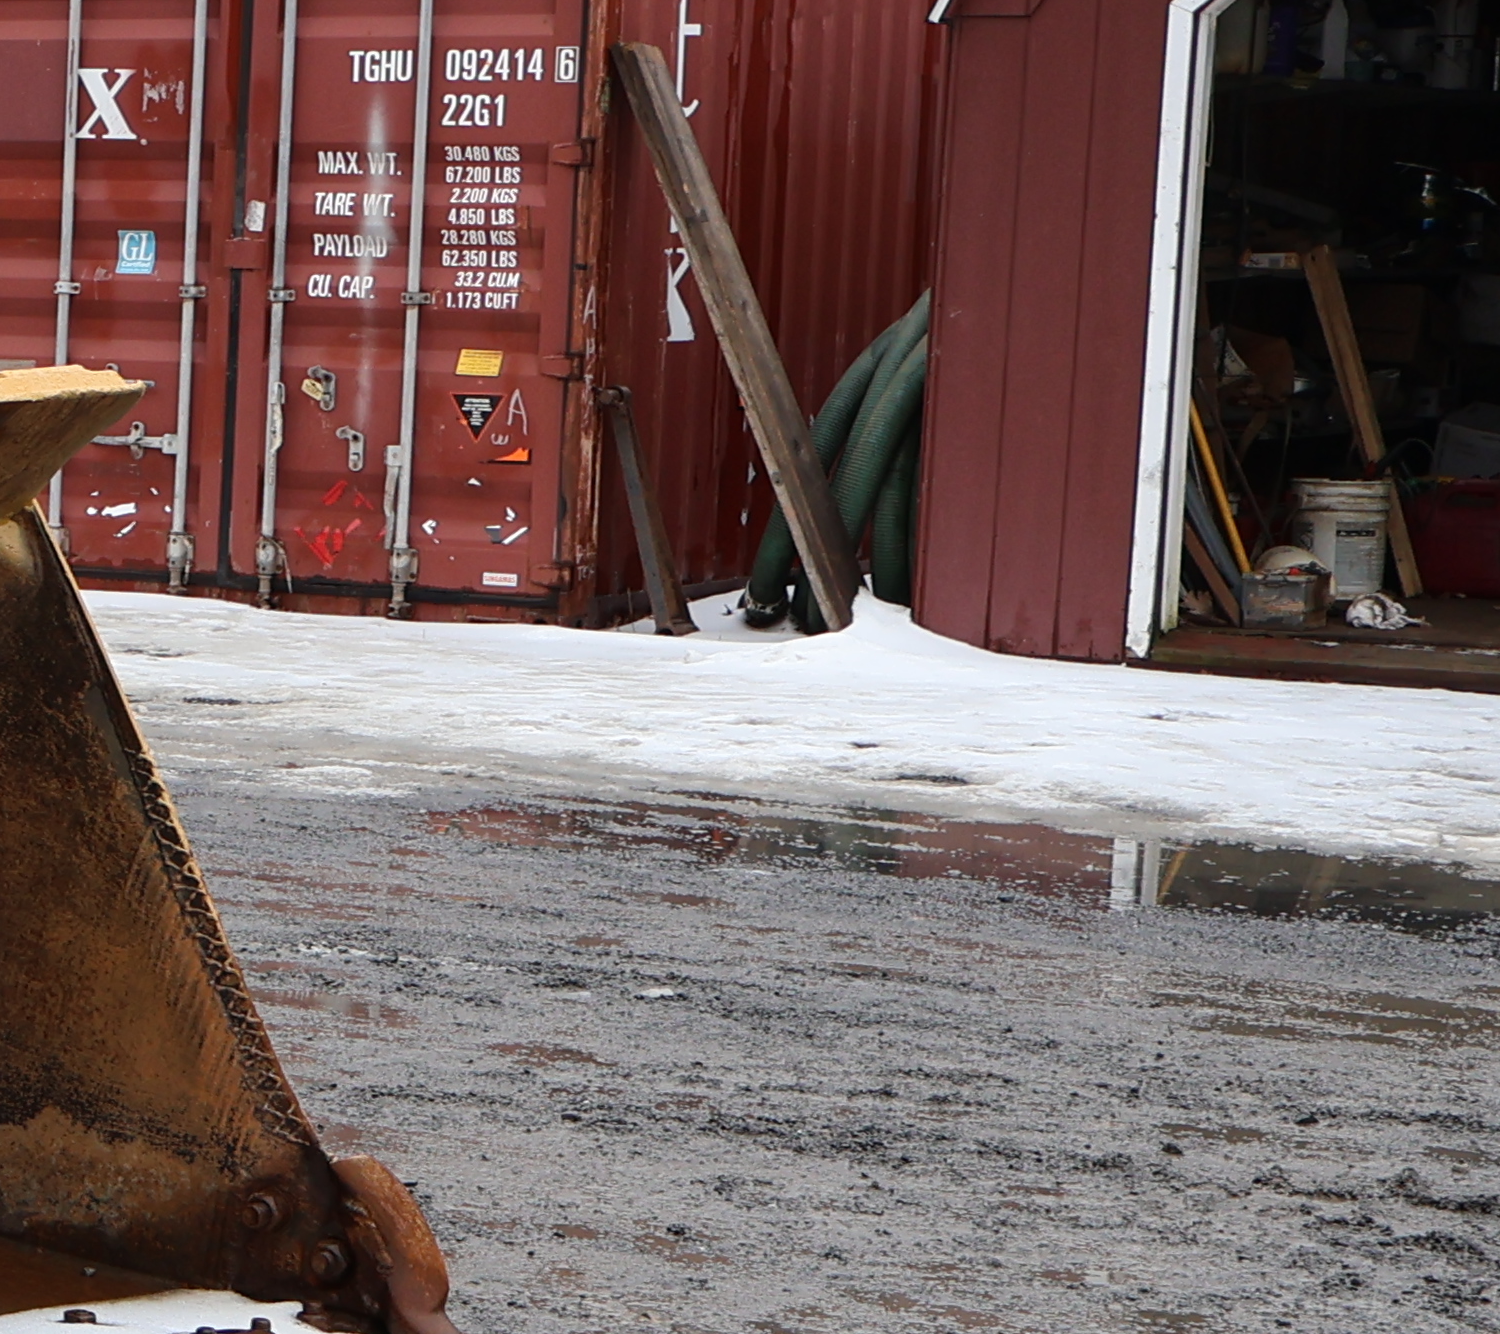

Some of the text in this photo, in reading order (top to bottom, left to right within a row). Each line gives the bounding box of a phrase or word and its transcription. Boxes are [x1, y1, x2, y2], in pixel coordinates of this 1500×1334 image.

[348, 48, 577, 83] TGHU 092414 6
[76, 68, 138, 140] X
[441, 93, 505, 127] 22G1
[318, 145, 521, 176] MAX. WT. 30.480 KGS
[445, 166, 521, 184] 67.200 LBS
[315, 188, 518, 217] TARE WT. 2.200 KGS
[448, 208, 515, 225] 4.850 LBS
[122, 232, 153, 261] GL
[313, 230, 517, 258] PAYLOAD 28.280 KGS
[442, 250, 517, 267] 62.350 LBS
[308, 274, 332, 298] CU.
[338, 275, 375, 299] CAP.
[455, 272, 483, 288] 33.2
[446, 292, 481, 309] 1.173
